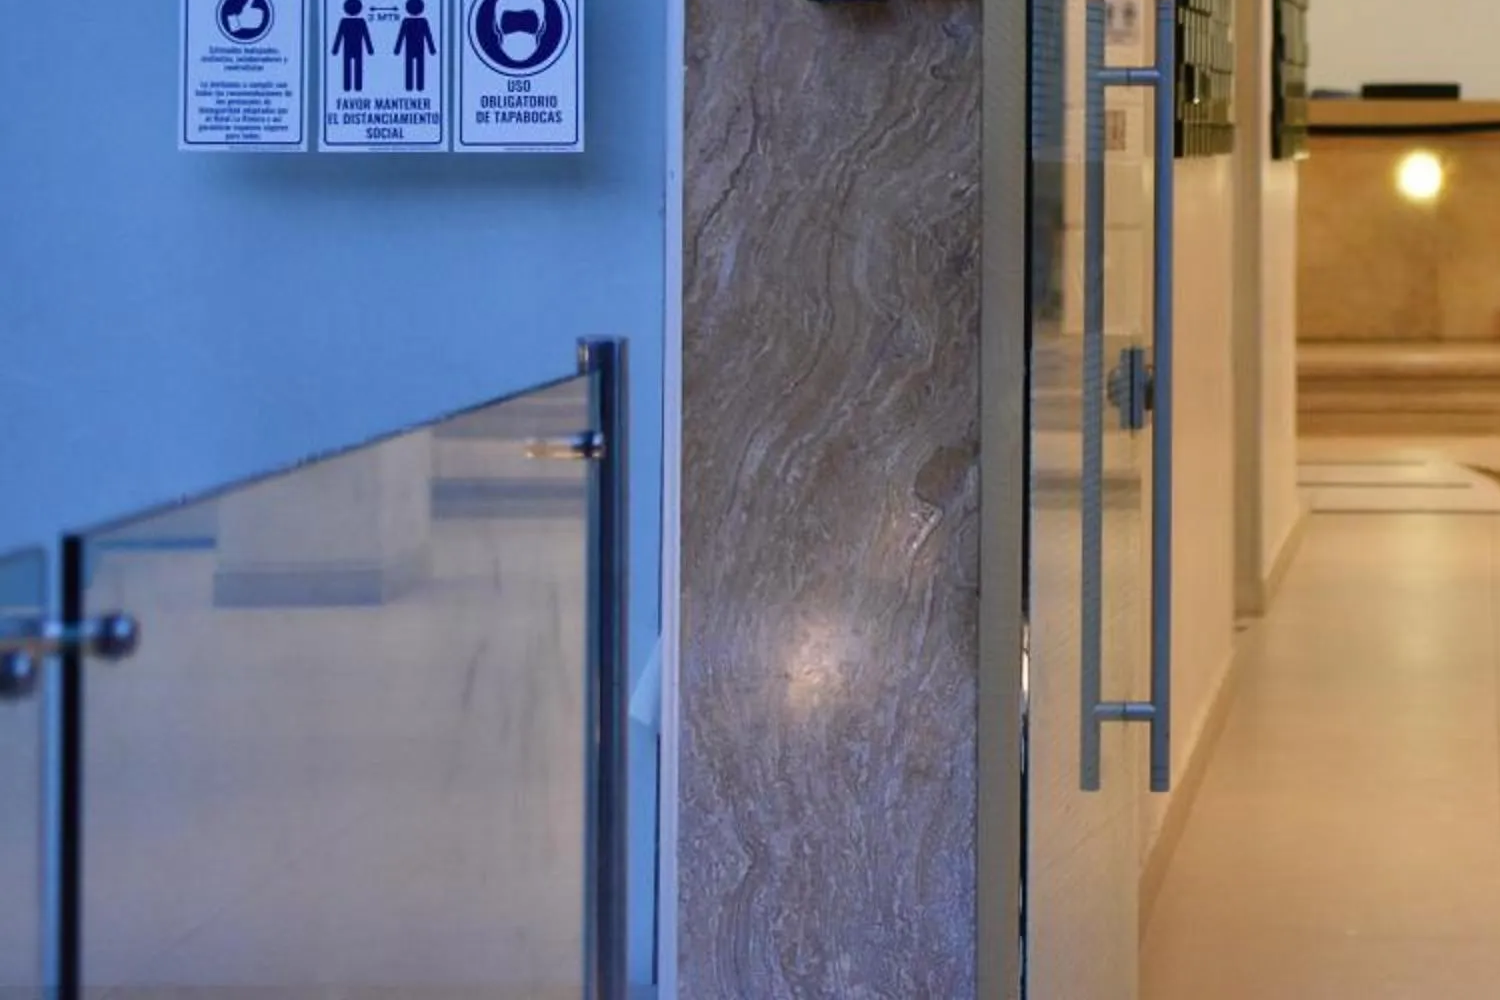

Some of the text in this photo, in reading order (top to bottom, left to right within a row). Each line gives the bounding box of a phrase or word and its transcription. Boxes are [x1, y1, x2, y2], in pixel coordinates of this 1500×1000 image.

[507, 80, 531, 92] USO
[336, 98, 431, 110] FAVOR MANTENER
[481, 96, 558, 108] OBLIGATORIO
[327, 112, 439, 124] EL DISTANCIAMIENTO
[476, 111, 563, 123] DE TAPABOCAS
[366, 127, 404, 139] SOCIAL
